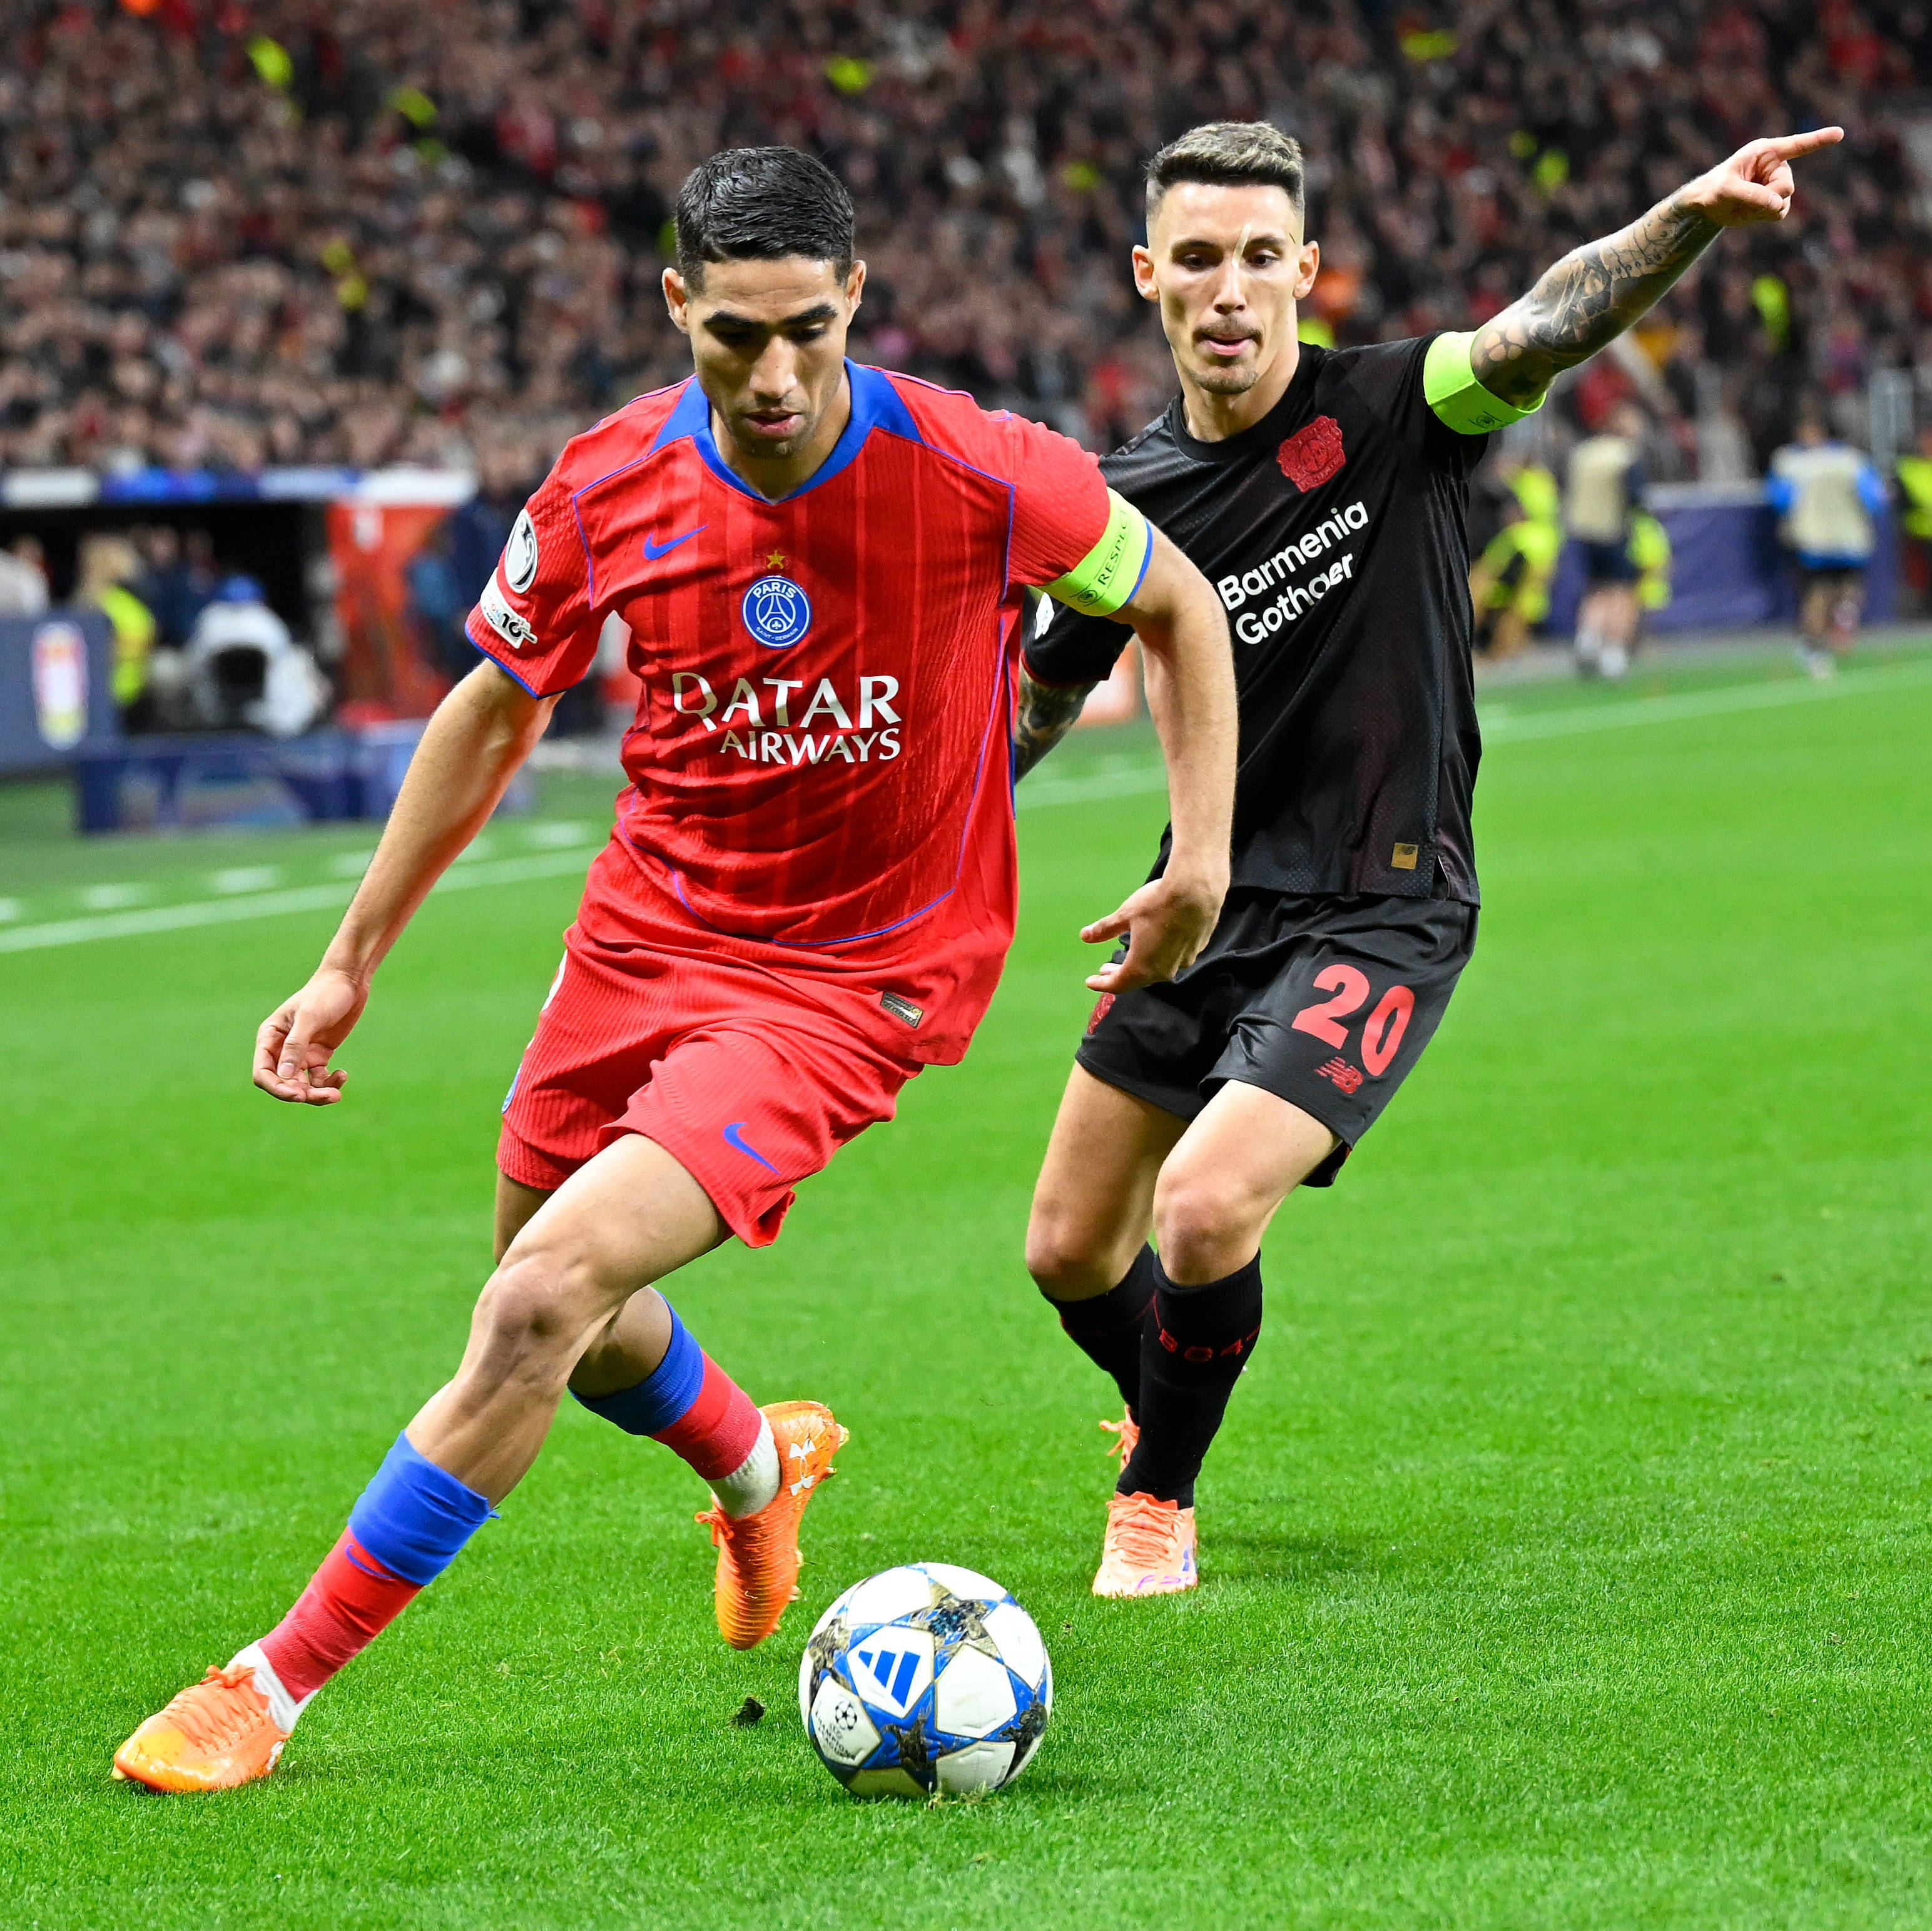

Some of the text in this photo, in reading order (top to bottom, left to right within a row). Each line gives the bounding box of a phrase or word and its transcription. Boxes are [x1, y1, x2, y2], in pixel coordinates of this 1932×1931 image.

[753, 582, 796, 599] PARIS
[1216, 501, 1369, 611] Barmenia
[1236, 552, 1354, 645] Gothaer
[672, 672, 902, 732] QATAR
[719, 727, 902, 766] AIRWAYS
[1291, 964, 1415, 1077] 20
